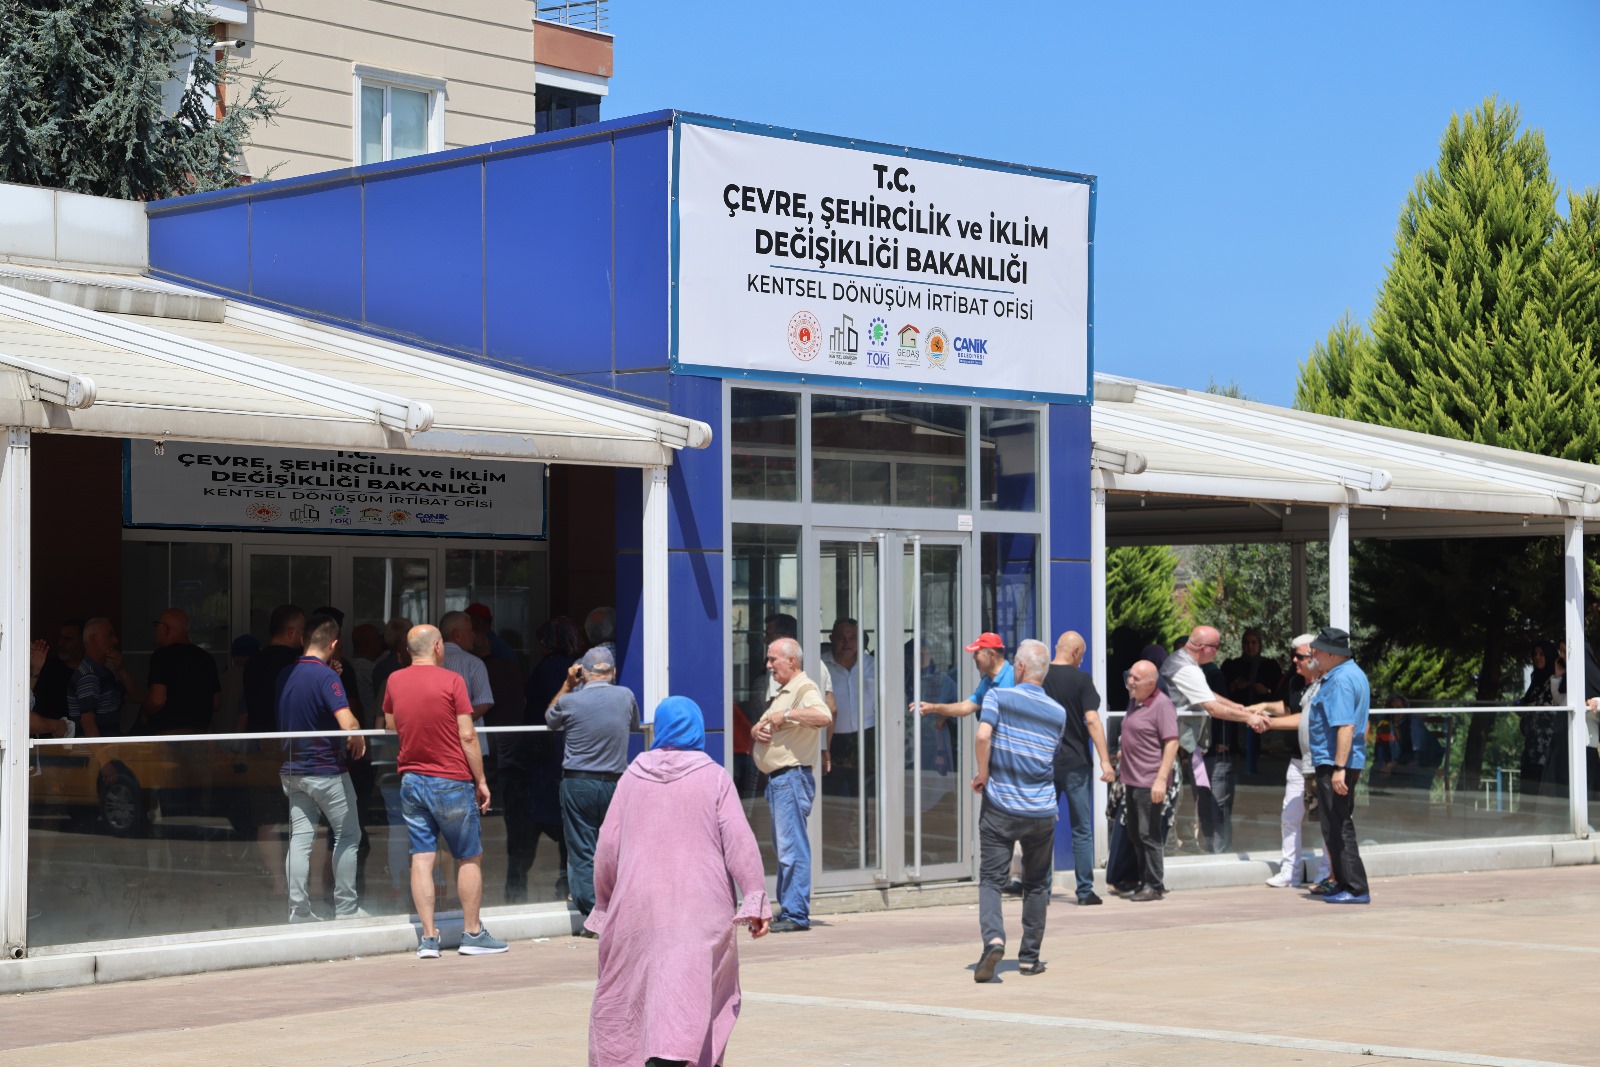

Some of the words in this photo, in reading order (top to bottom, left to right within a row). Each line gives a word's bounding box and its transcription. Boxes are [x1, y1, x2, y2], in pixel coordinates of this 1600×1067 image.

[873, 164, 915, 193] T.C.
[723, 184, 813, 224] ÇEVRE,
[820, 195, 951, 237] ŞEHİRCİLİK
[957, 220, 982, 240] ve
[990, 211, 1048, 249] İKLİM
[755, 227, 898, 269] DEĞİŞİKLİĞİ
[906, 247, 1027, 284] BAKANLIĞI
[747, 274, 827, 299] KENTSEL
[833, 280, 921, 311] DÖNÜŞÜM
[927, 288, 989, 316] İRTİBAT
[994, 298, 1033, 320] OFİSİ
[177, 453, 272, 471] ÇEVRE,
[279, 459, 412, 480] ŞEHİRCİLİK
[418, 469, 443, 479] ve
[450, 467, 506, 483] İKLİM
[211, 470, 361, 489] DEĞİŞİKLİĞİ
[367, 479, 487, 495] BAKANLIĞI
[203, 487, 287, 499] KENTSEL
[292, 489, 383, 504] DÖNÜŞÜM
[387, 492, 450, 507] İRTİBAT
[454, 496, 493, 509] OFİSİ
